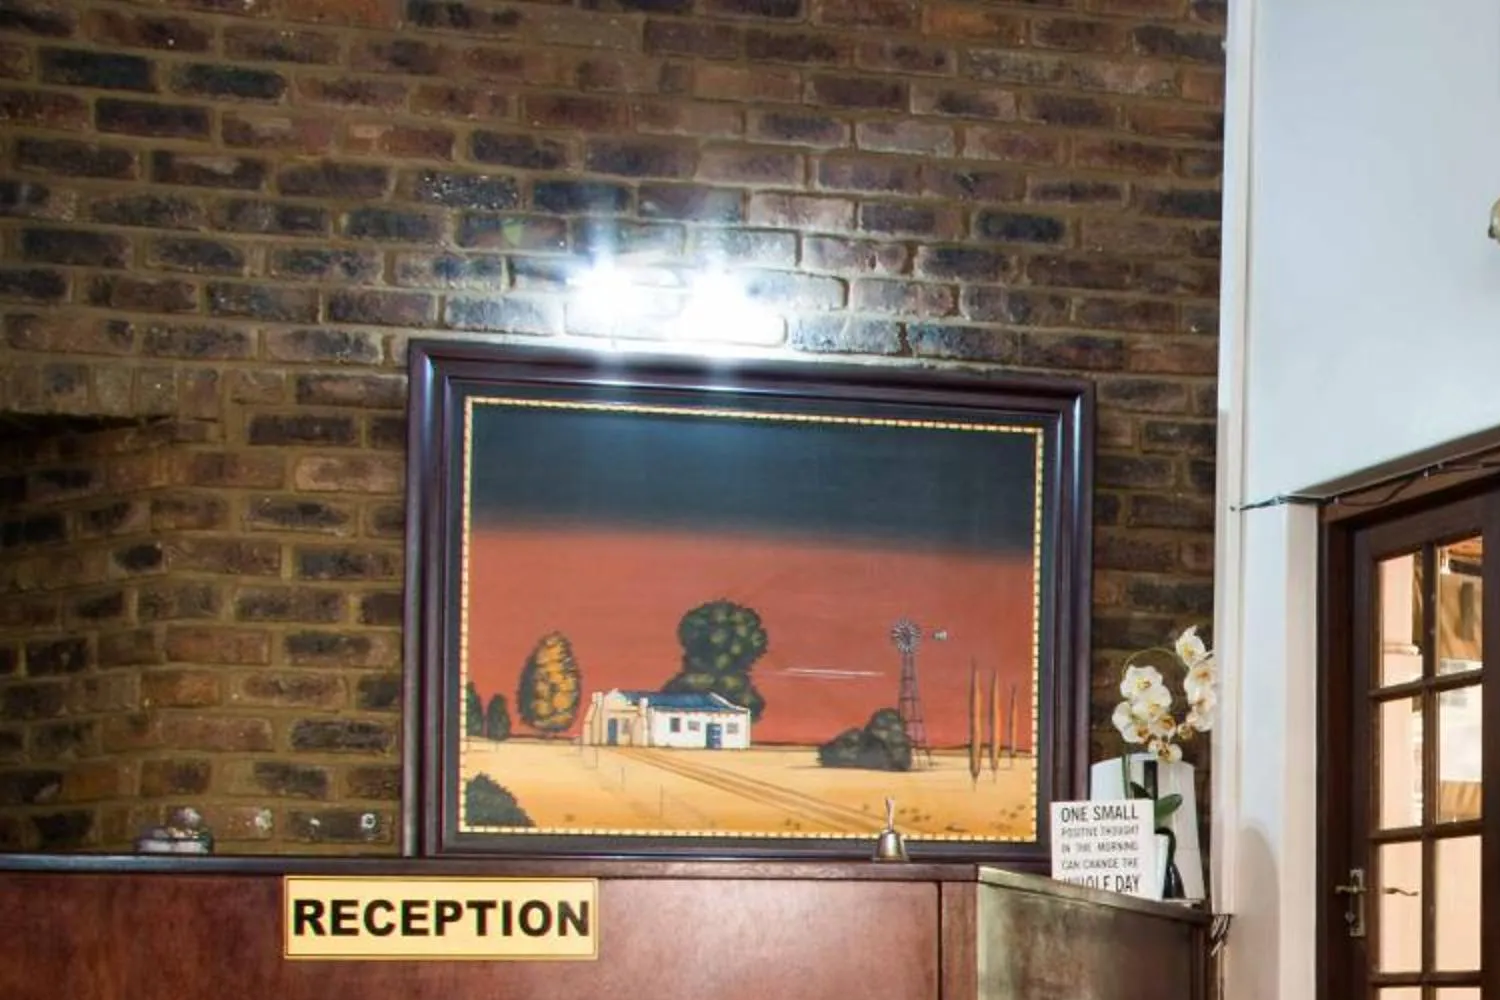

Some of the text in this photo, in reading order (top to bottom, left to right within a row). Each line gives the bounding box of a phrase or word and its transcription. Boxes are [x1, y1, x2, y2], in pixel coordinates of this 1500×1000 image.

[1061, 803, 1139, 823] ONE SMALL
[1061, 827, 1098, 838] POSITIVE
[1097, 841, 1138, 852] MORNING
[1061, 859, 1079, 871] CAN
[1083, 858, 1119, 870] CHANGE
[1115, 874, 1141, 893] DAY
[293, 899, 590, 937] RECEPTION
